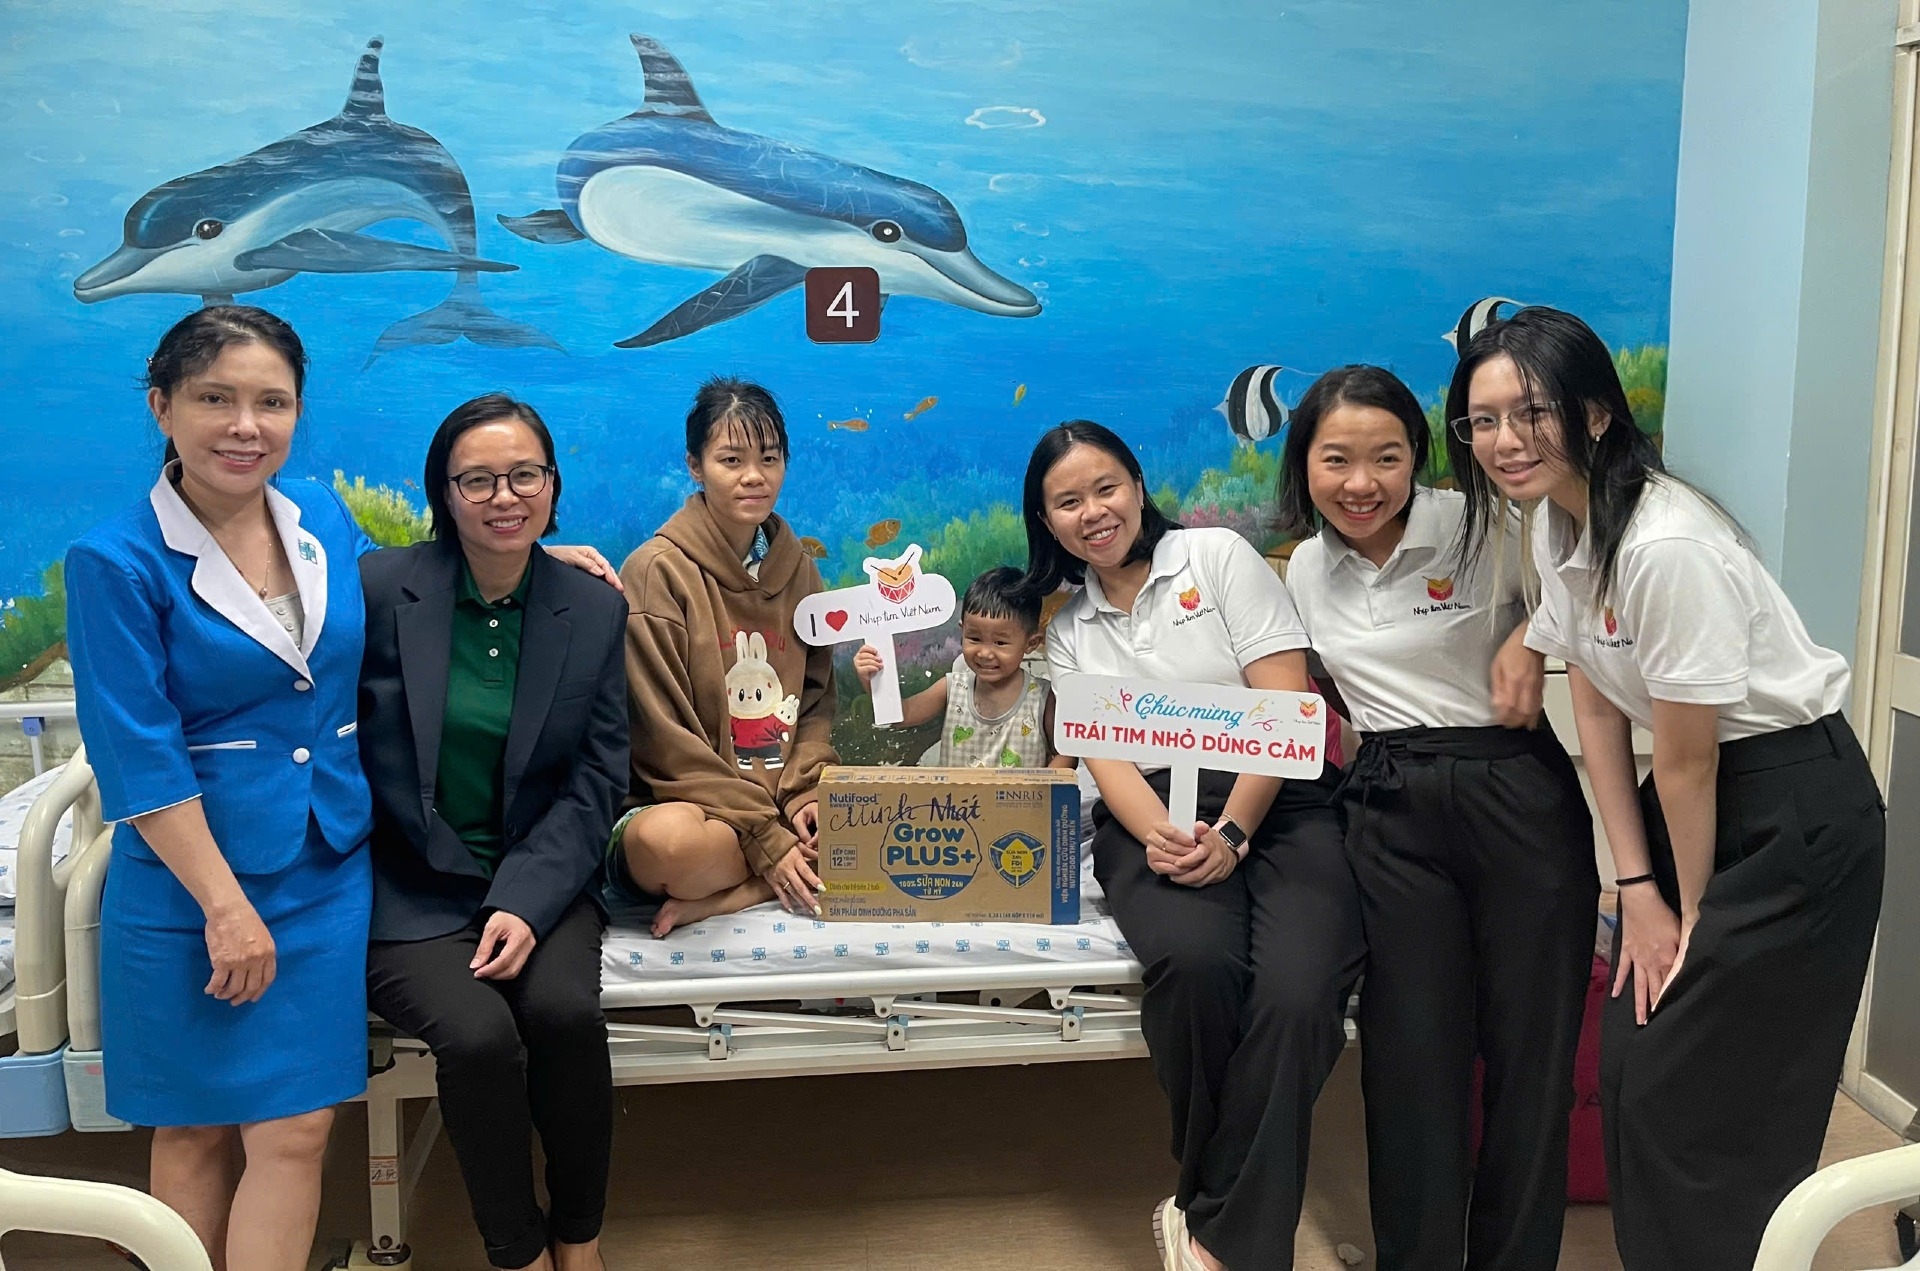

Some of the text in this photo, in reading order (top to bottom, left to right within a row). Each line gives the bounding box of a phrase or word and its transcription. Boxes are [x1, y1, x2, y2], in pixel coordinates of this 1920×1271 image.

[826, 281, 860, 328] 4
[918, 603, 942, 615] Nam
[809, 613, 817, 637] I
[1135, 693, 1245, 730] Chúc mừng
[1063, 721, 1316, 761] TRÁI TIM NHỎ DŨNG CẢM
[830, 793, 877, 803] Nutifood
[893, 822, 966, 843] Grow
[832, 856, 843, 867] 12
[887, 845, 976, 866] PLUS+
[934, 877, 951, 888] NON
